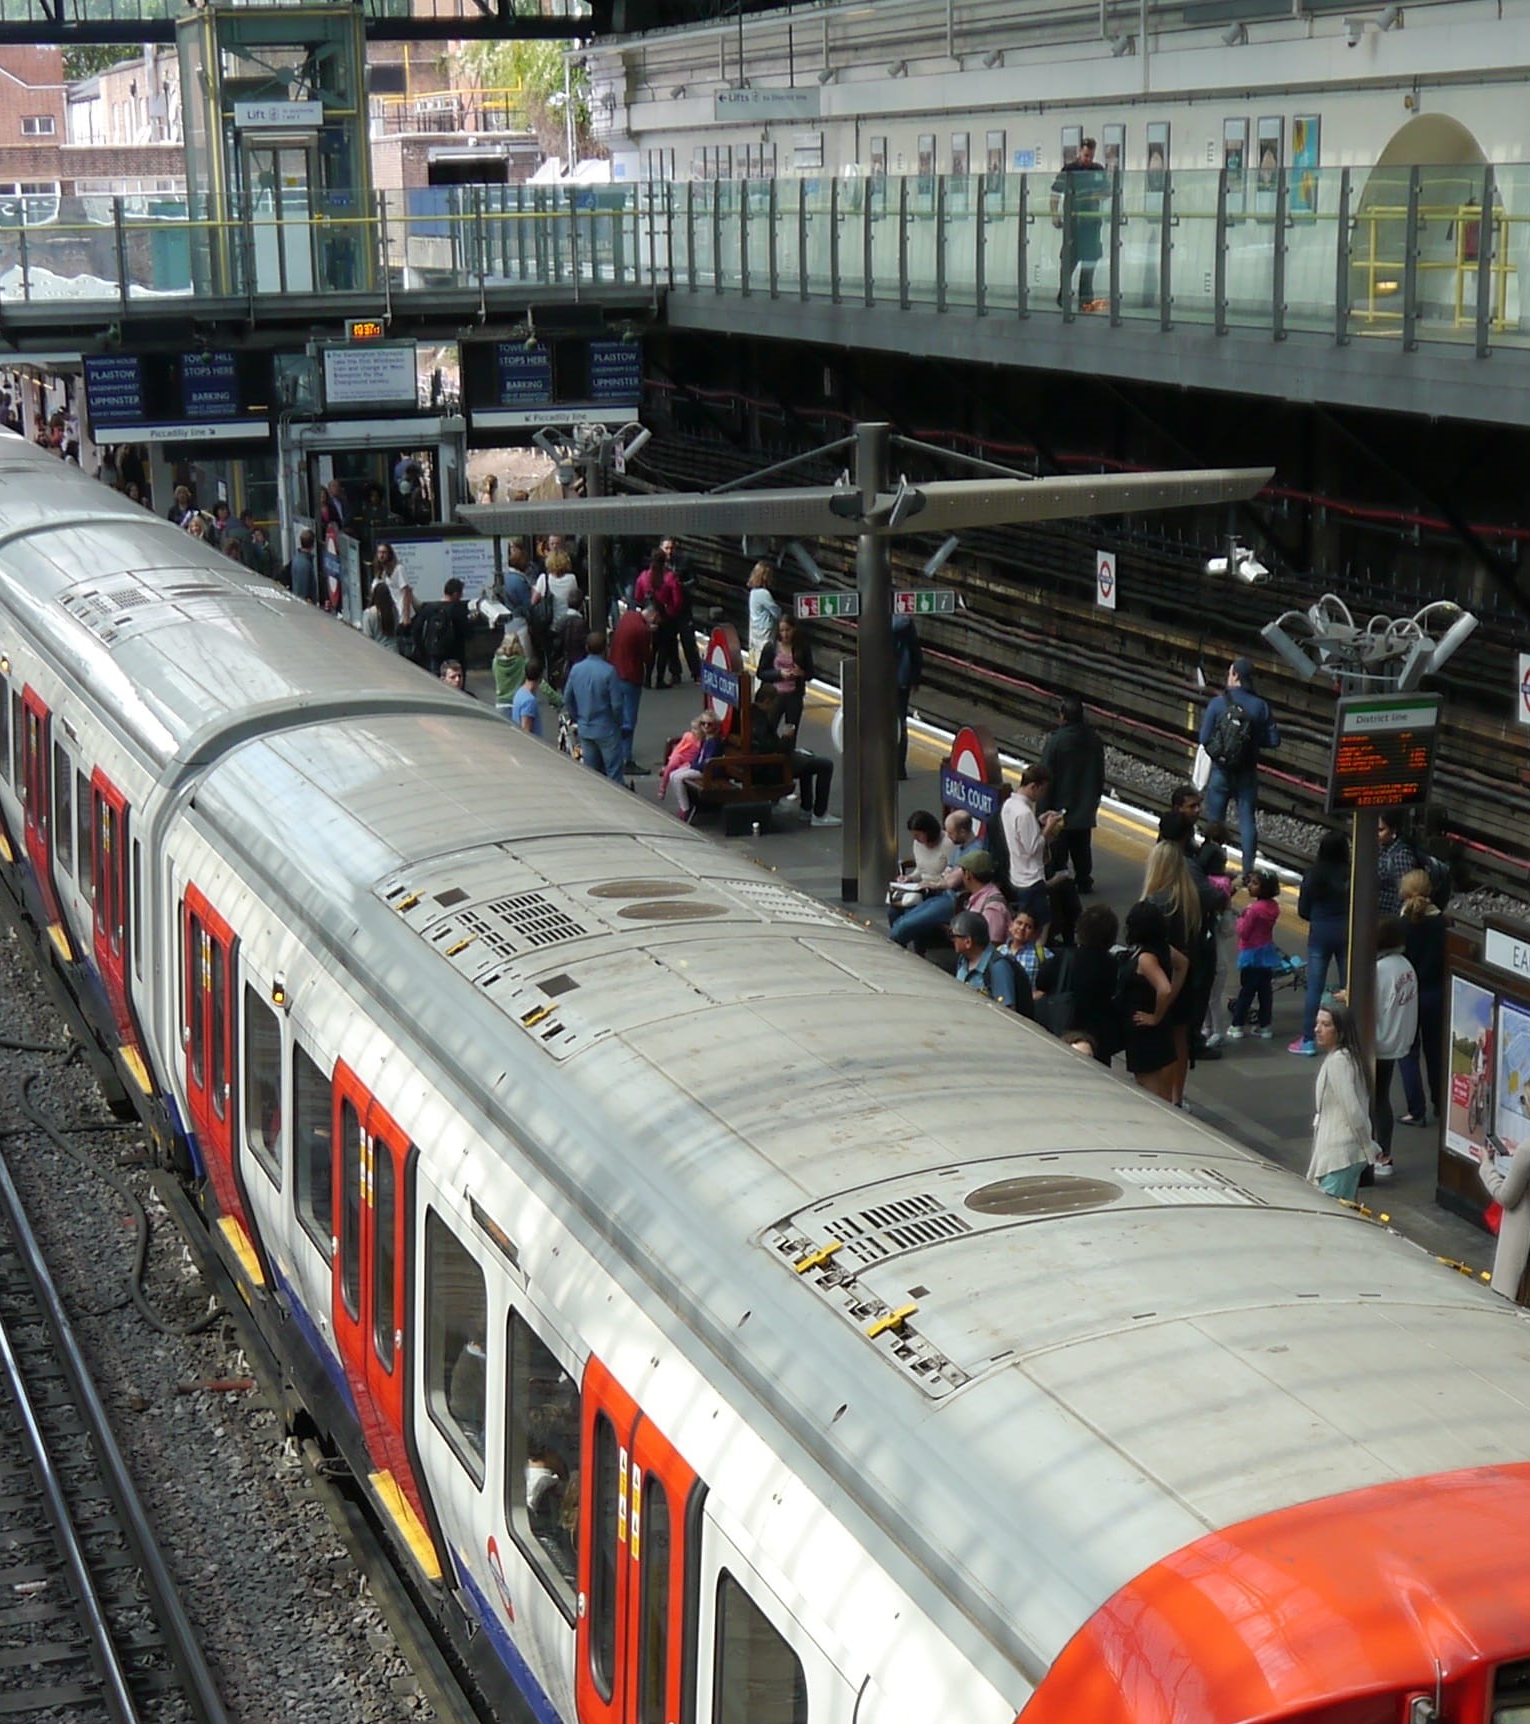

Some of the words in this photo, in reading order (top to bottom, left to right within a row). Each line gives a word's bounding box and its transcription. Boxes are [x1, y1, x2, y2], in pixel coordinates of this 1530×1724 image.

[247, 109, 266, 120] Lift
[719, 675, 739, 697] COURT
[1355, 714, 1389, 724] District
[1390, 713, 1408, 721] line
[944, 776, 967, 803] EARL'S
[967, 787, 993, 815] COURT
